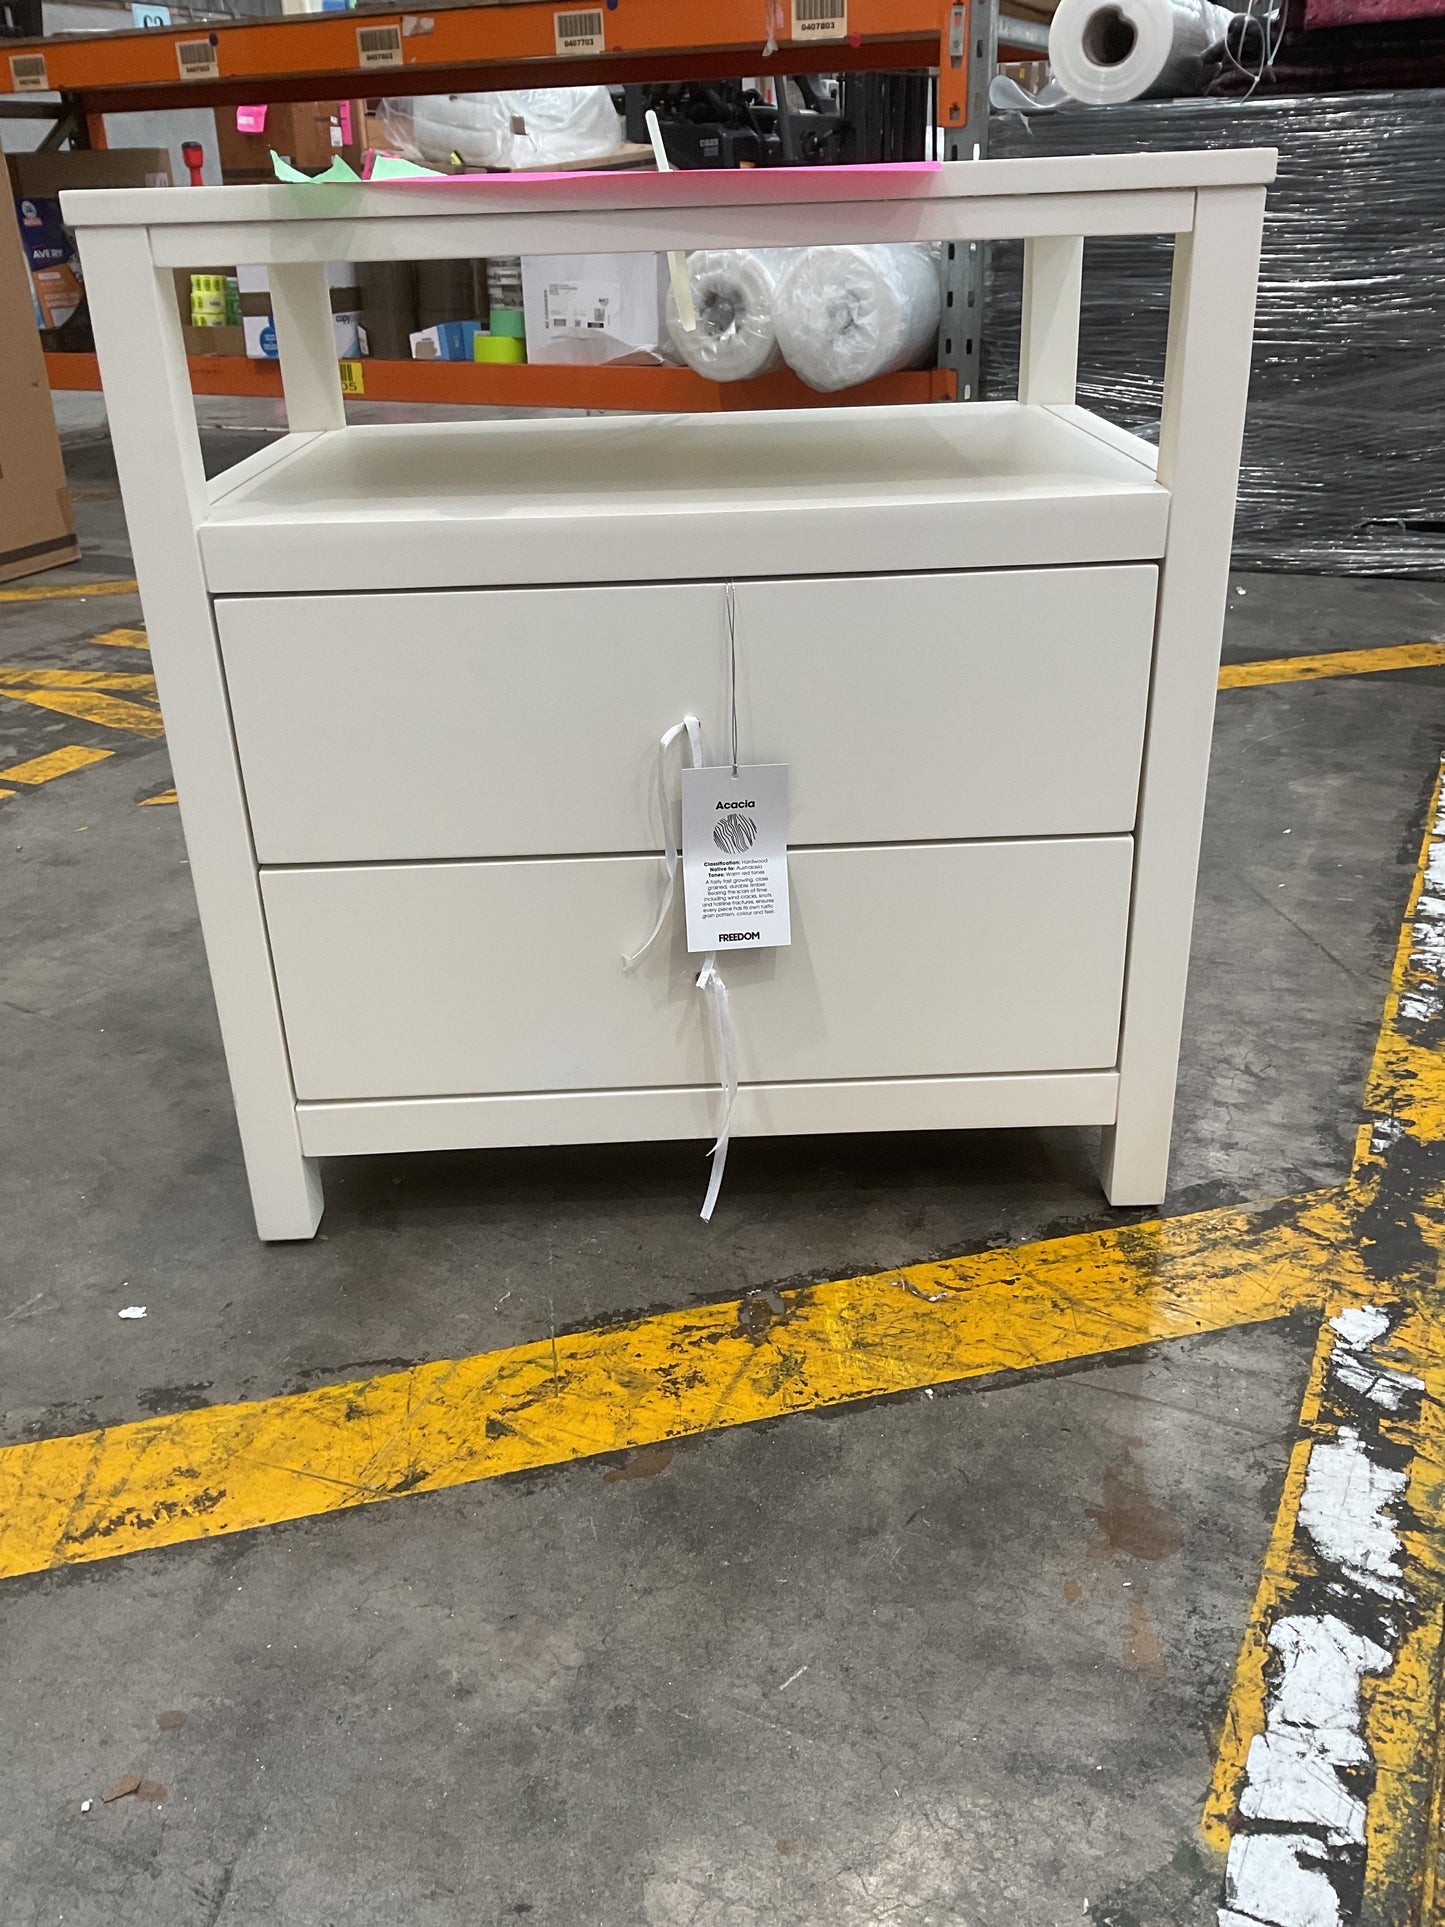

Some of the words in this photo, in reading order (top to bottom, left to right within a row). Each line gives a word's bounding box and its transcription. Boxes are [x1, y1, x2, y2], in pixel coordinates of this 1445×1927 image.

[802, 22, 834, 30] 0407803
[33, 249, 62, 258] AVERY
[716, 800, 756, 810] Acacia
[719, 932, 760, 942] FREEDOM
